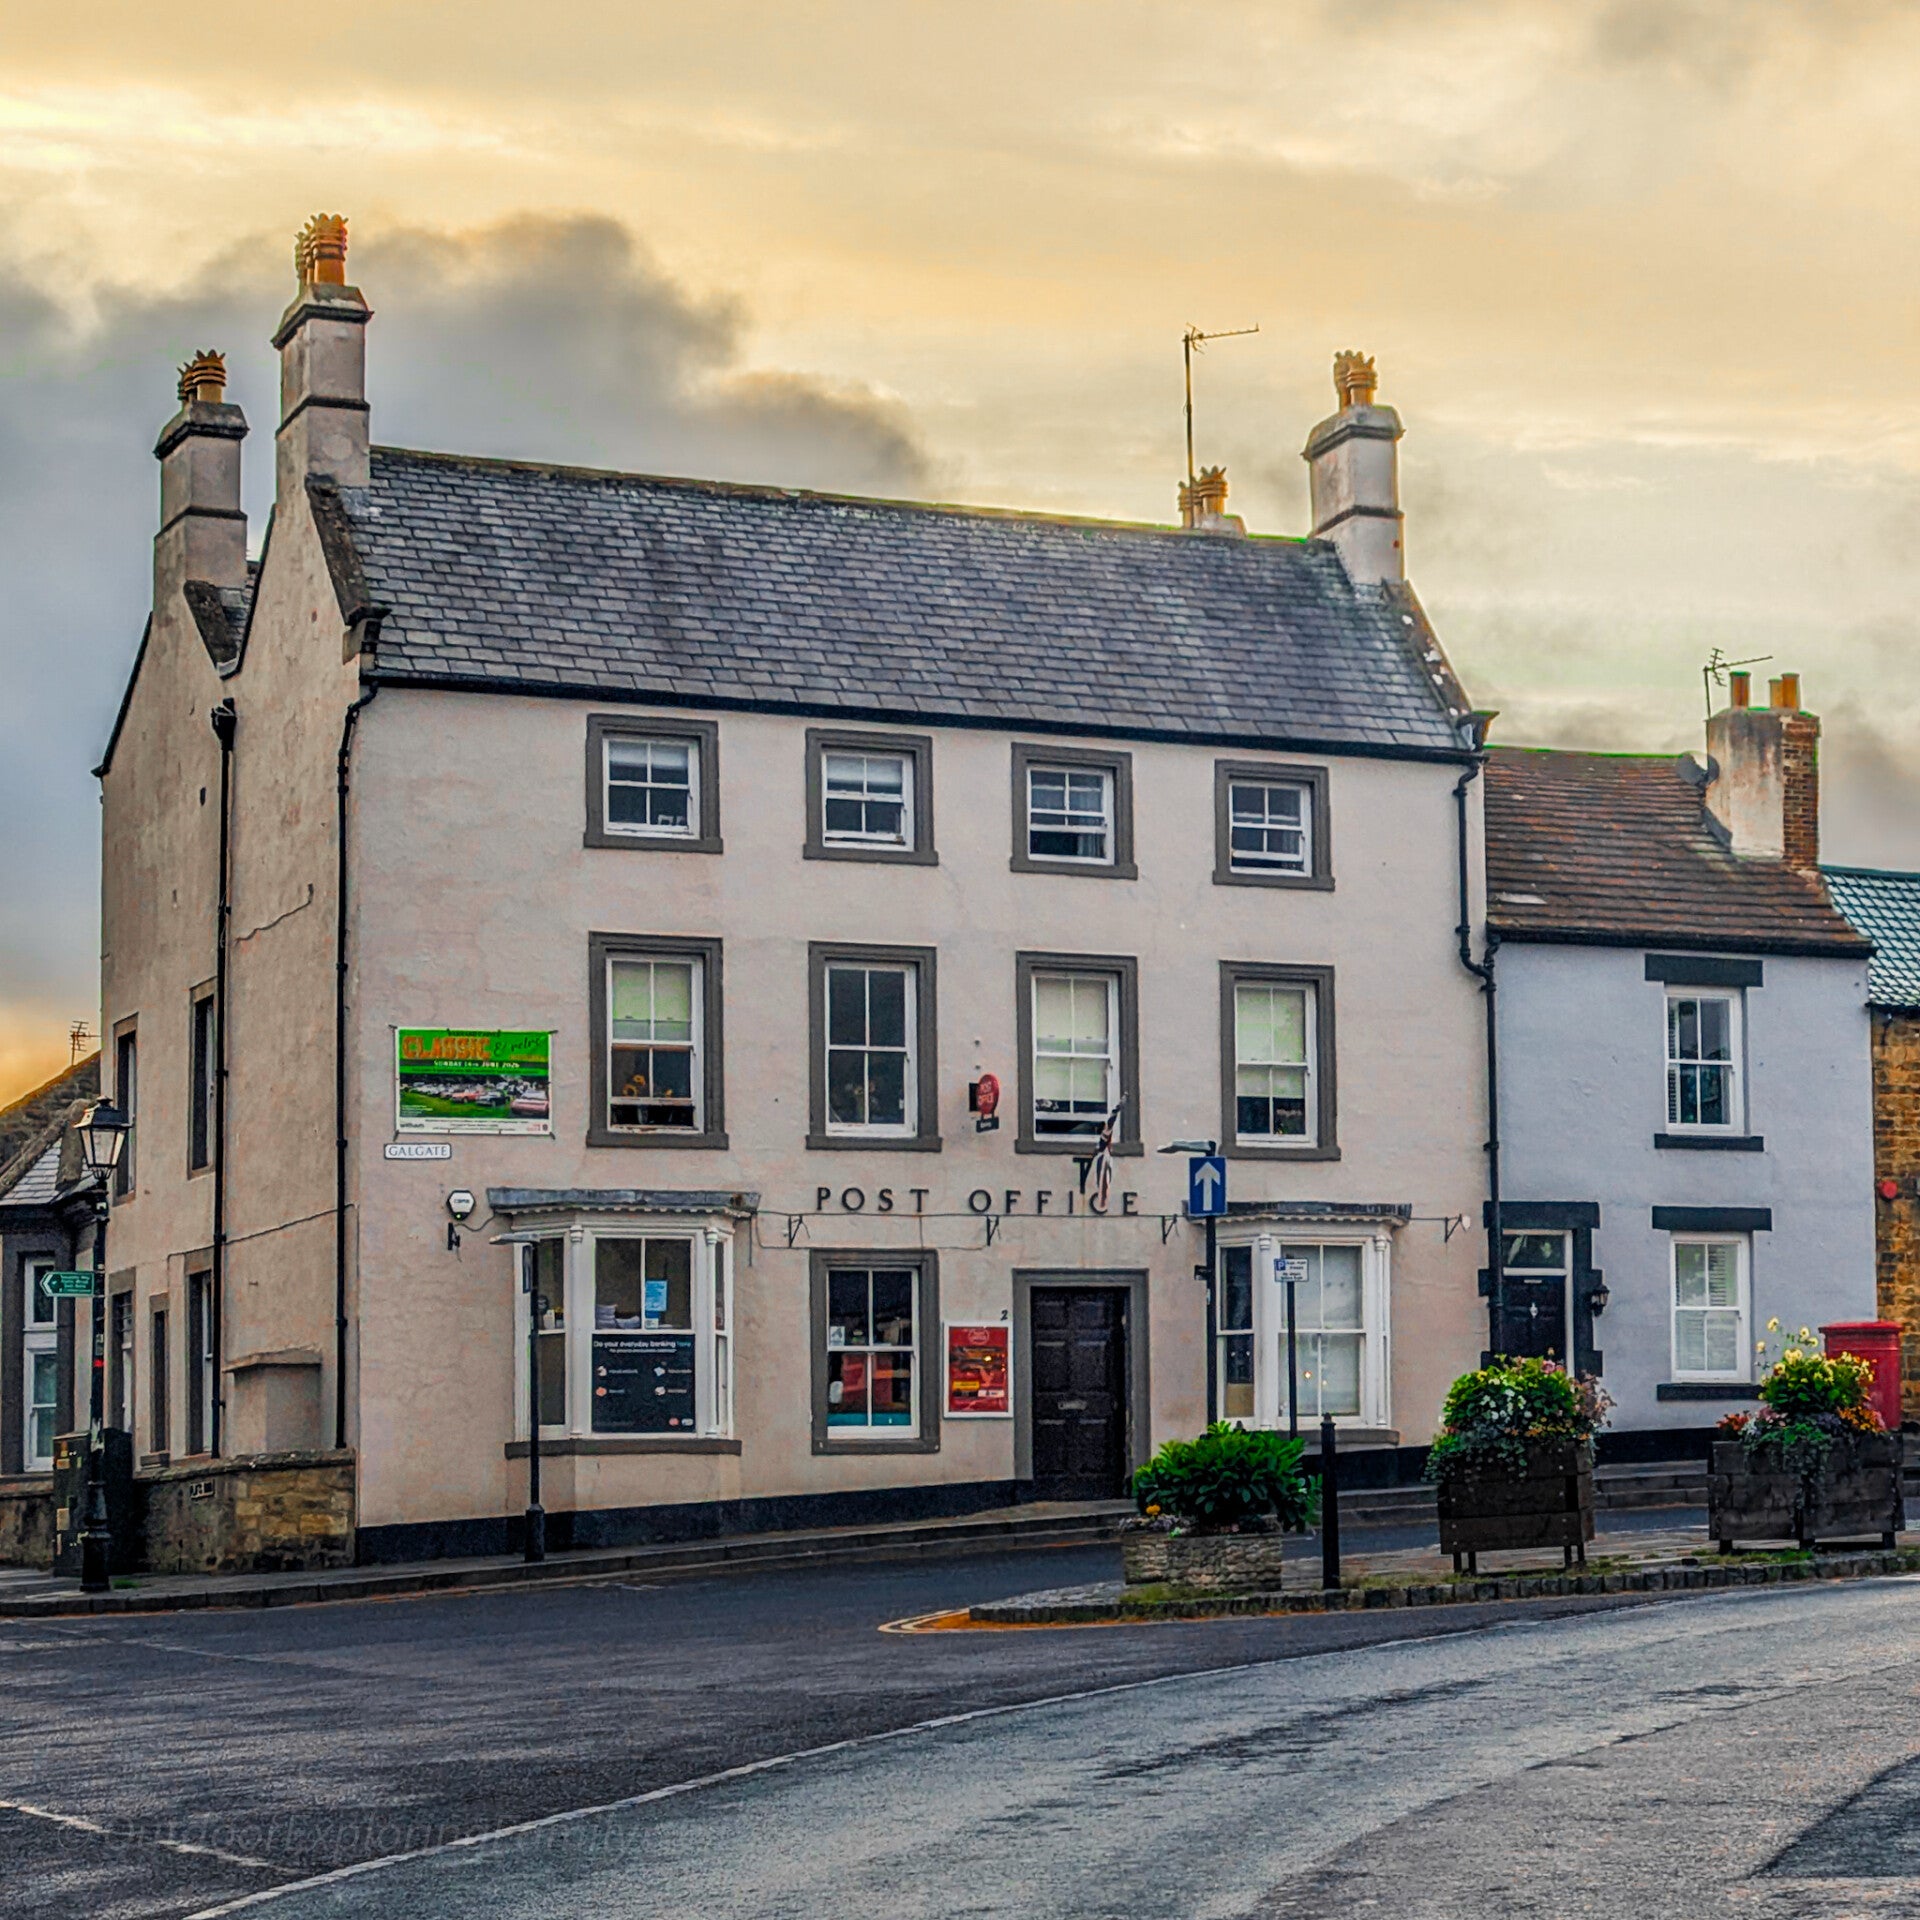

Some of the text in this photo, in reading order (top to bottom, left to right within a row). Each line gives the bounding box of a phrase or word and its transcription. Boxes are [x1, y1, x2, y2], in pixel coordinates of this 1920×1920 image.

[402, 1036, 490, 1059] CLASSIC
[388, 1146, 448, 1157] GALGATE
[816, 1187, 1140, 1216] POST OFFICE
[1000, 1310, 1008, 1320] 2
